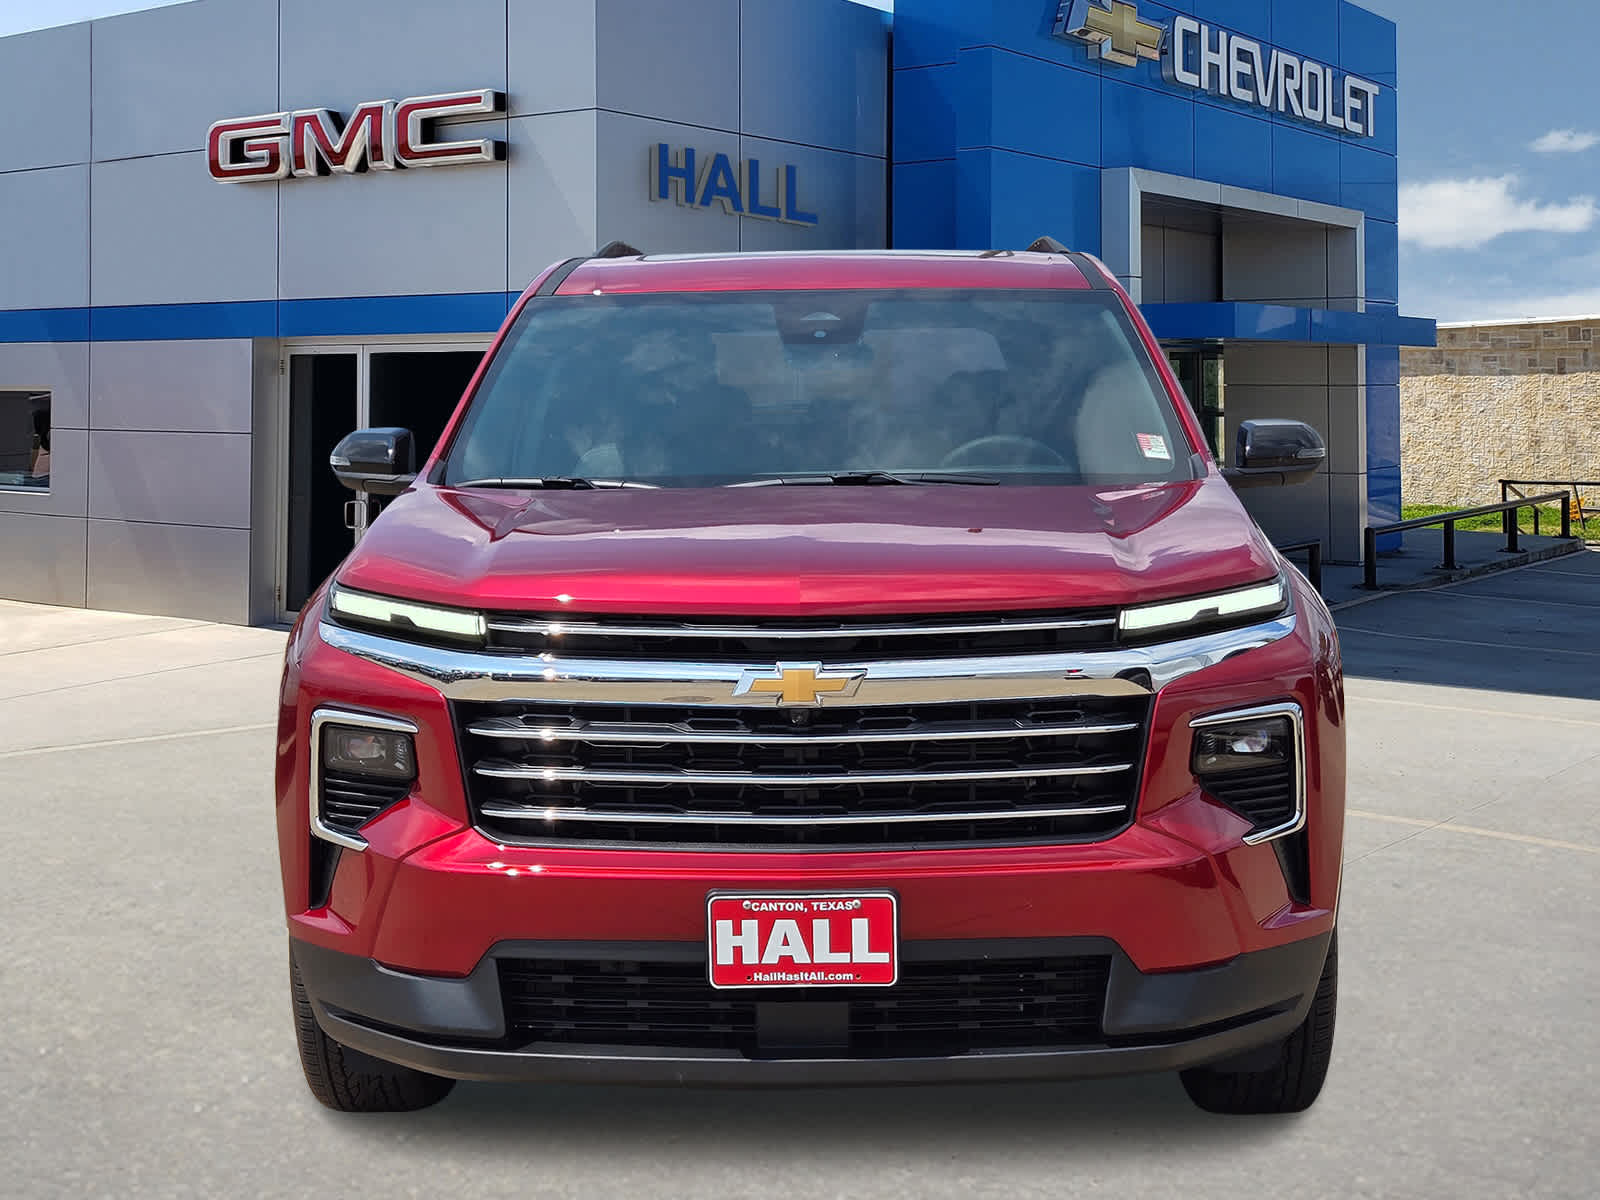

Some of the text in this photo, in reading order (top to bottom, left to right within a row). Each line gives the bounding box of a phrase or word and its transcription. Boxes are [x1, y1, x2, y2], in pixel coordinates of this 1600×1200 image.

[1173, 14, 1380, 137] CHEVROLET
[207, 88, 506, 184] GMC
[654, 142, 819, 226] HALL
[751, 900, 854, 913] CANTON, TEXAS
[715, 918, 890, 965] HALL
[753, 971, 854, 982] HallHasItAll.com
